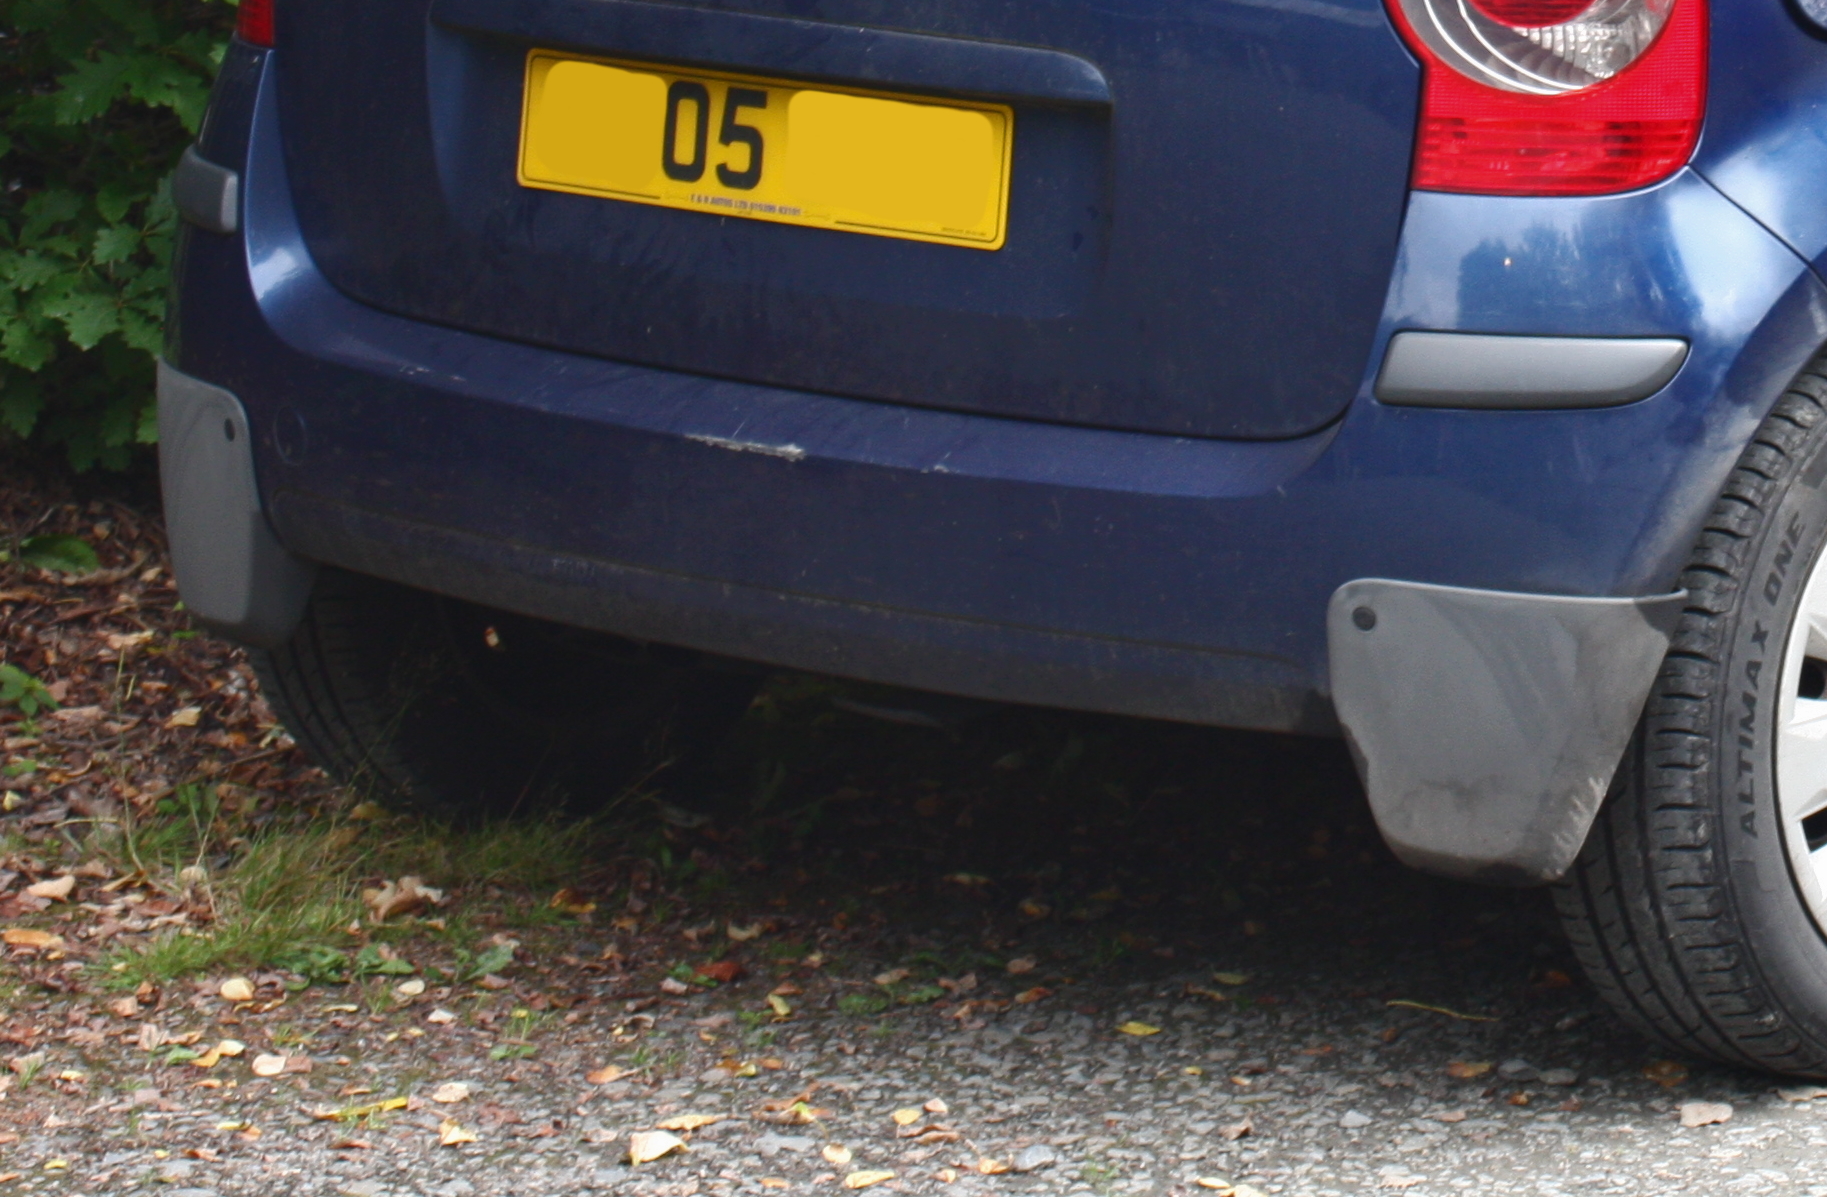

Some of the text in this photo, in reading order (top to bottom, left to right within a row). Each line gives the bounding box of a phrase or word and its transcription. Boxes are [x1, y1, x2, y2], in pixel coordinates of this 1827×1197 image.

[661, 80, 768, 191] 05
[1738, 511, 1807, 840] ALTIMAX ONE
